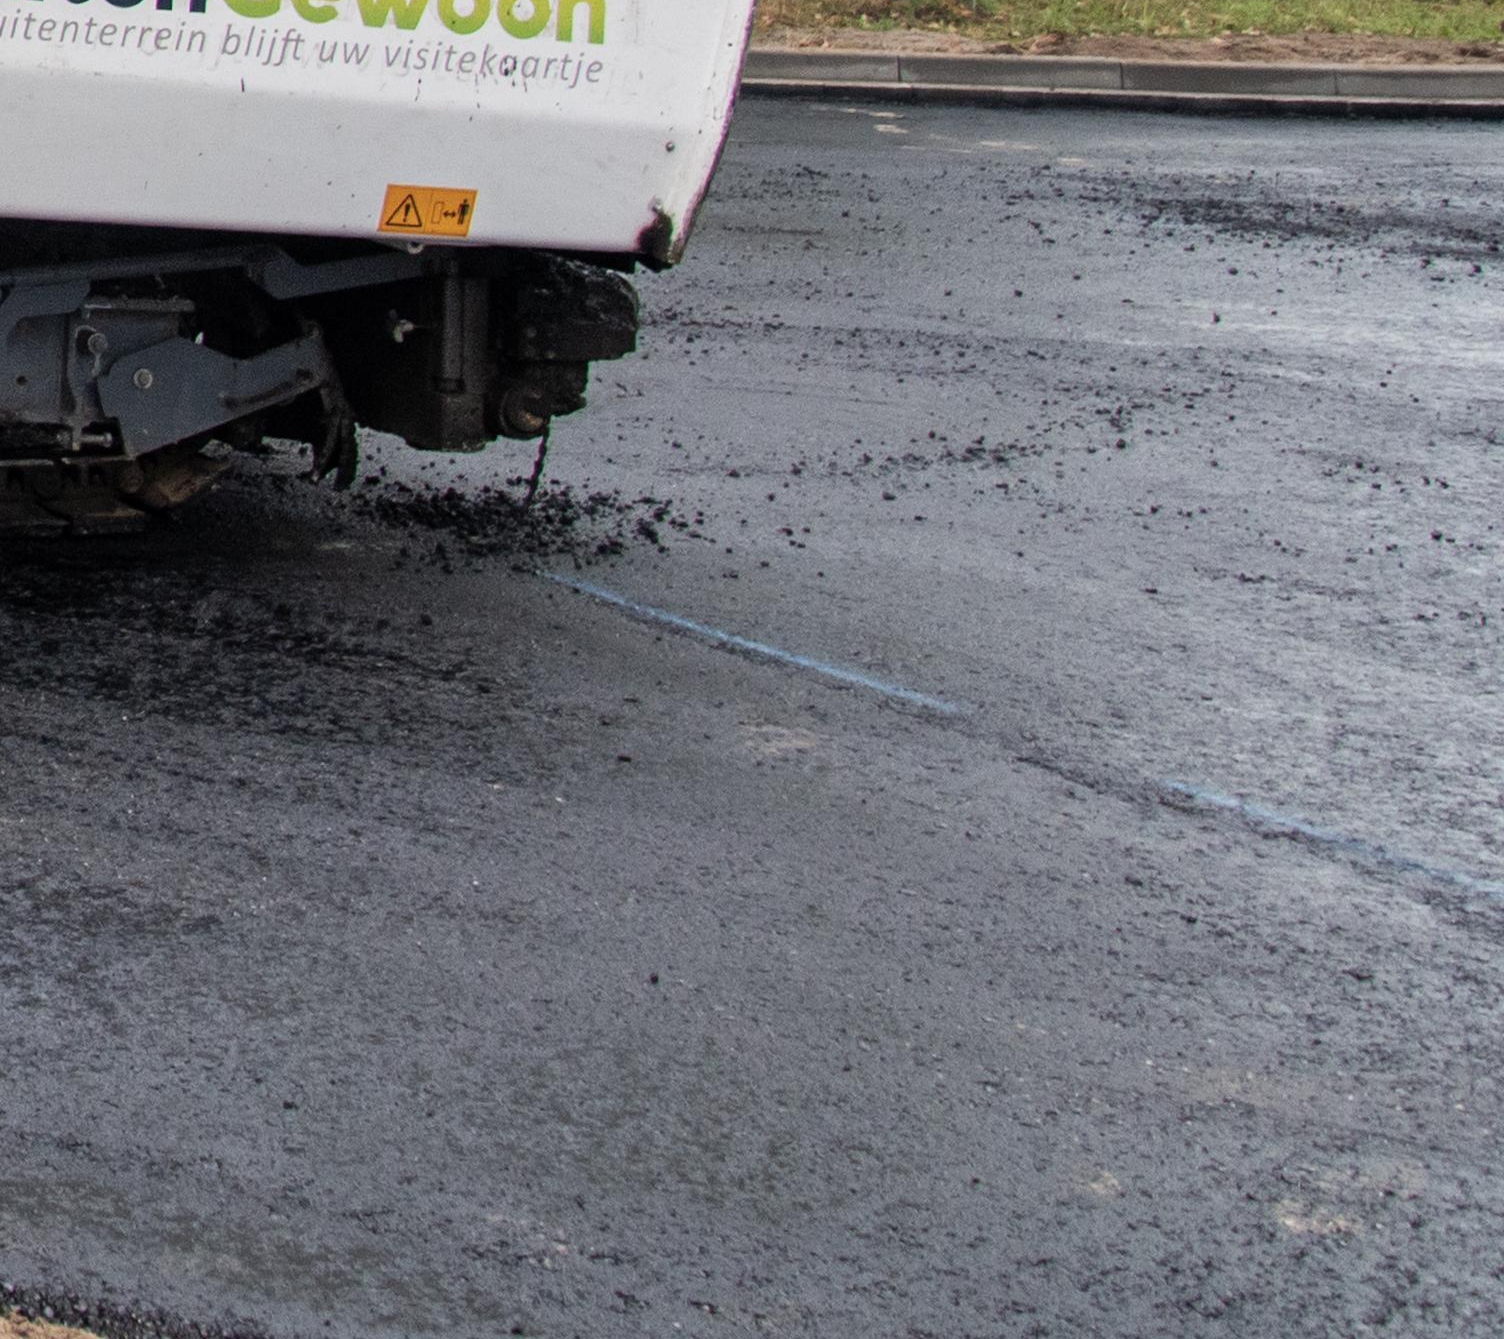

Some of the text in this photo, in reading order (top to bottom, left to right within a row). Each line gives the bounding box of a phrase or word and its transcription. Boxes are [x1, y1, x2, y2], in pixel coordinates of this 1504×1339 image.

[220, 24, 305, 66] blijft
[318, 40, 370, 66] uw
[385, 40, 605, 90] visitekaartje
